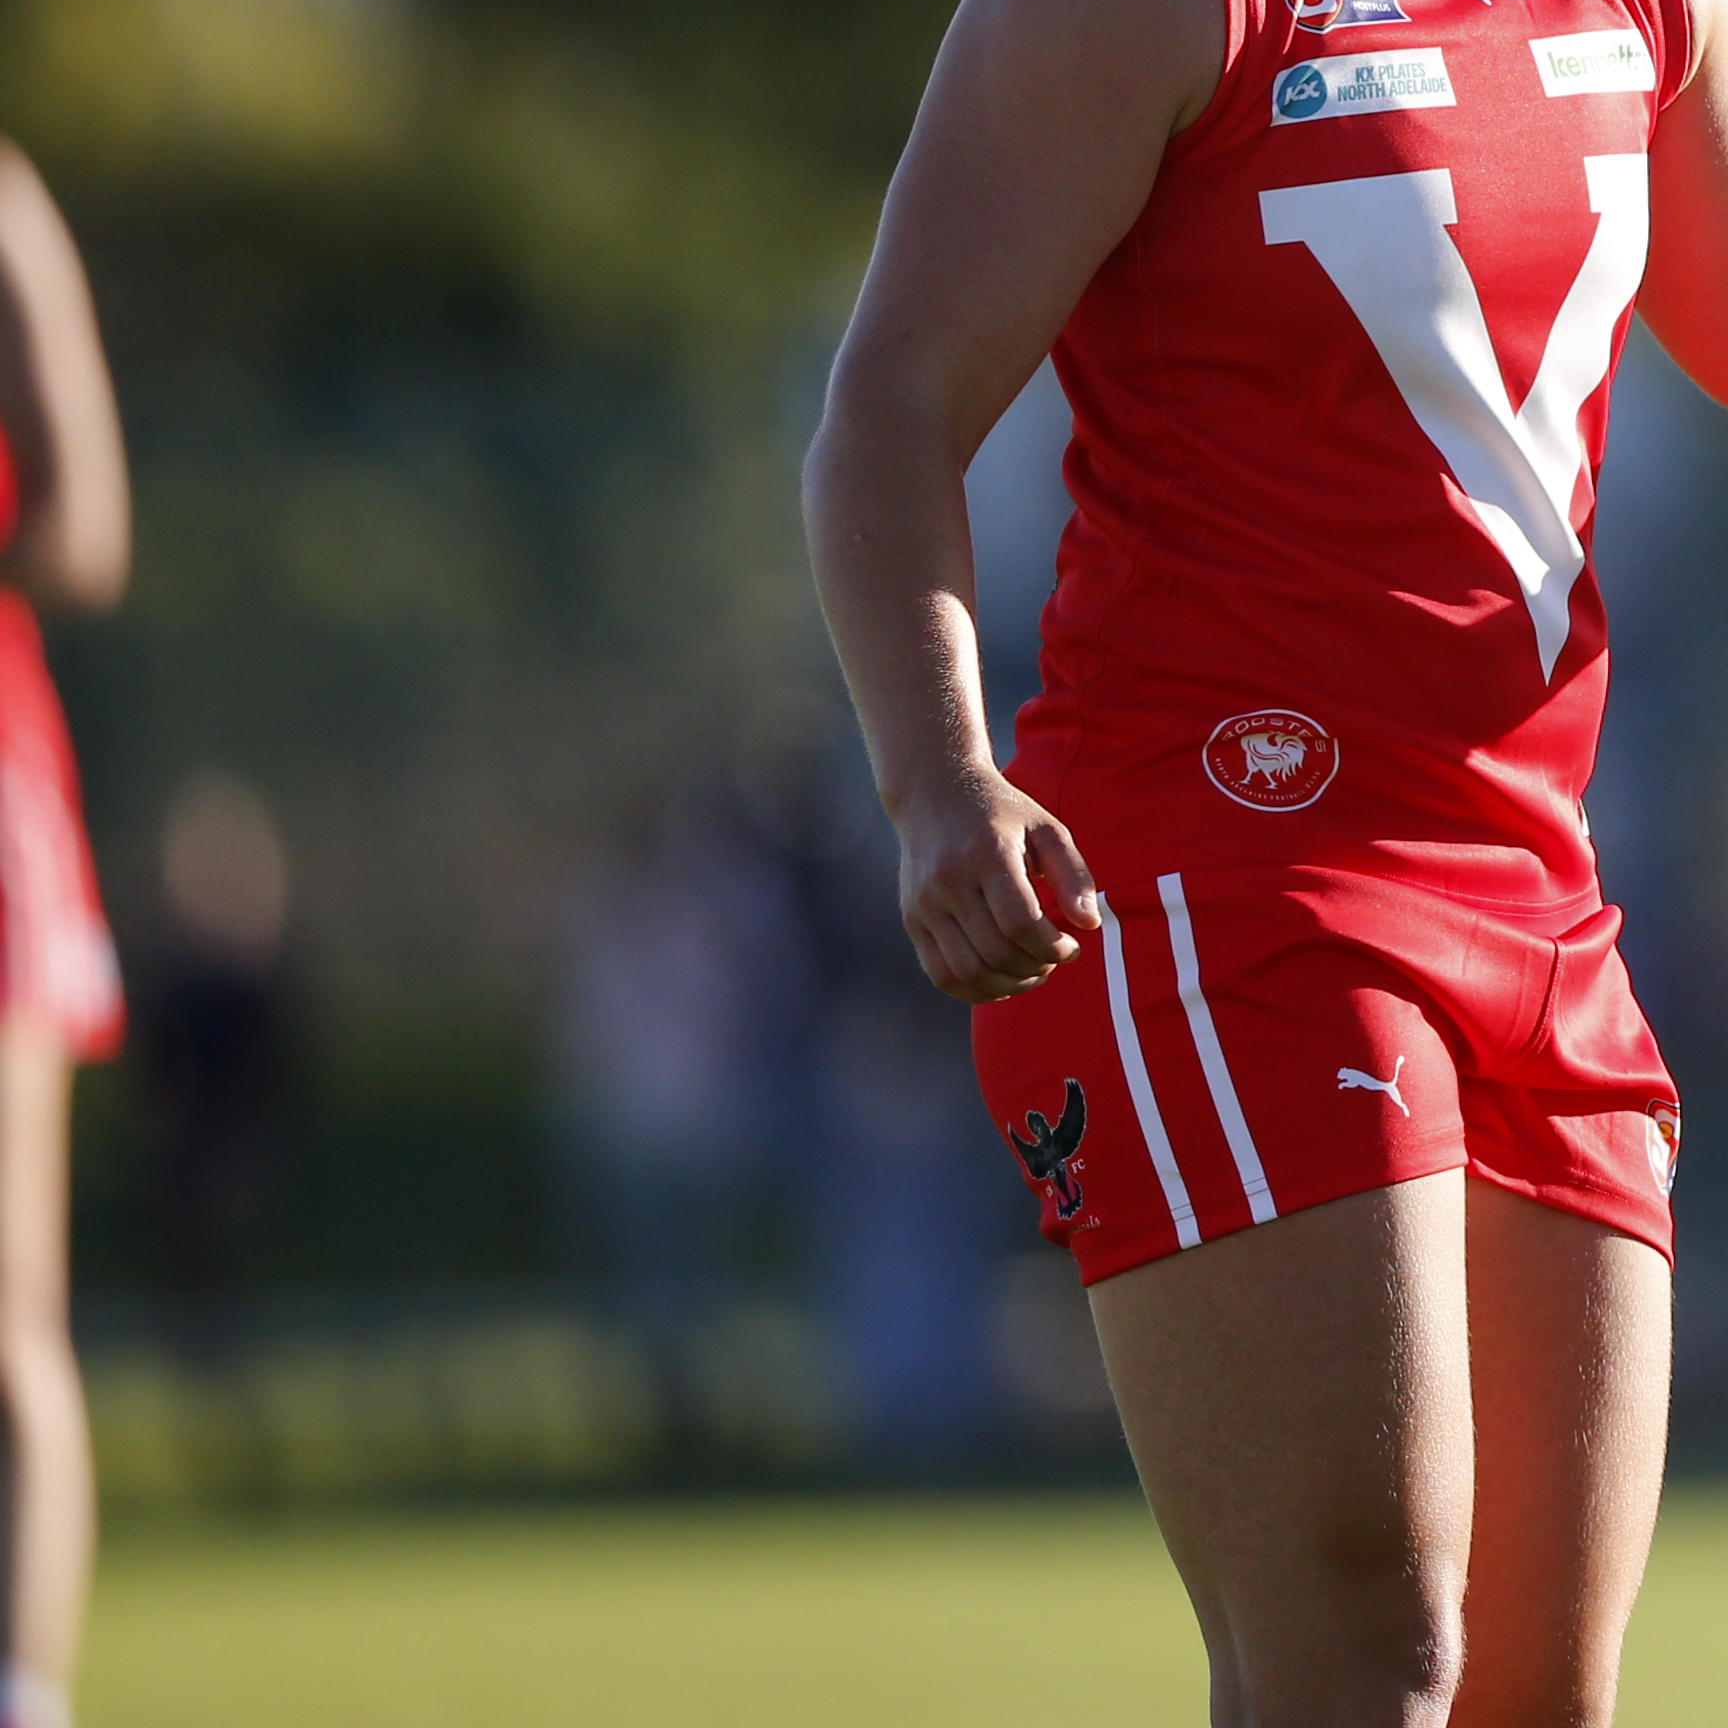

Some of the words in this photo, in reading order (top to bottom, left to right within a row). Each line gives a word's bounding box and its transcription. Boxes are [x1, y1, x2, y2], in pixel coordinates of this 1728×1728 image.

[1353, 1, 1392, 13] HOSTPLUS
[1355, 65, 1374, 83] KX
[1378, 62, 1426, 80] PILATES
[1284, 80, 1321, 106] KX
[1337, 82, 1386, 102] NORTH
[1389, 77, 1447, 96] ADELAIDE
[1071, 1159, 1086, 1174] FC
